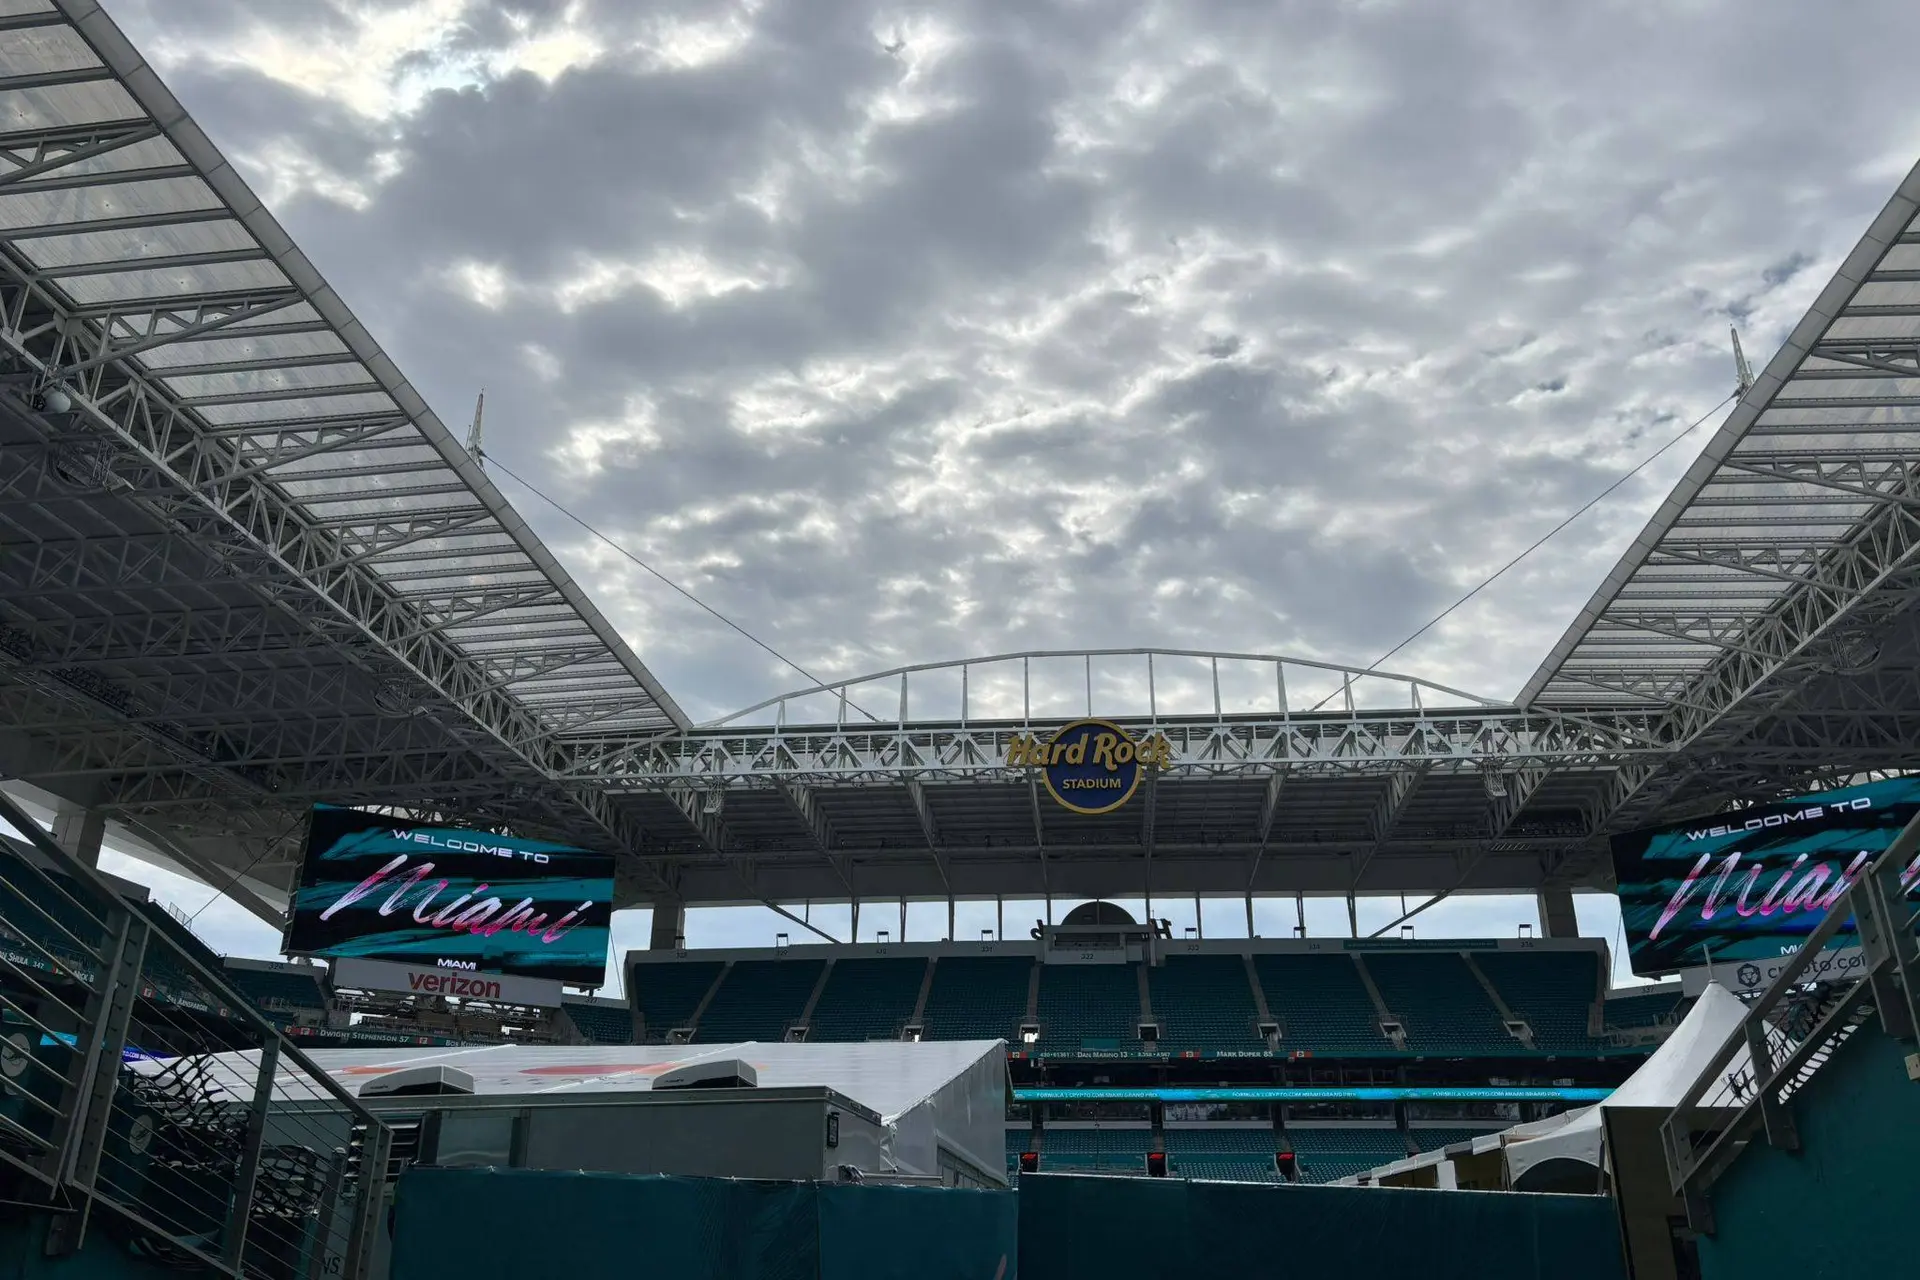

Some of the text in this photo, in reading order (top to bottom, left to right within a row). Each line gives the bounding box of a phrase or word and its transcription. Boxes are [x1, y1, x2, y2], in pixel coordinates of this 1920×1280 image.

[1006, 732, 1171, 771] Hard Rock
[1062, 778, 1121, 789] STADIUM
[1829, 797, 1871, 813] TO
[519, 850, 550, 864] TO
[319, 854, 593, 944] Miami
[8, 952, 28, 965] SHULA
[32, 961, 45, 969] 347
[437, 958, 476, 970] MIAMI
[408, 972, 500, 998] verizon
[320, 1029, 350, 1038] DWIGHT
[353, 1030, 397, 1042] STEPHENSON
